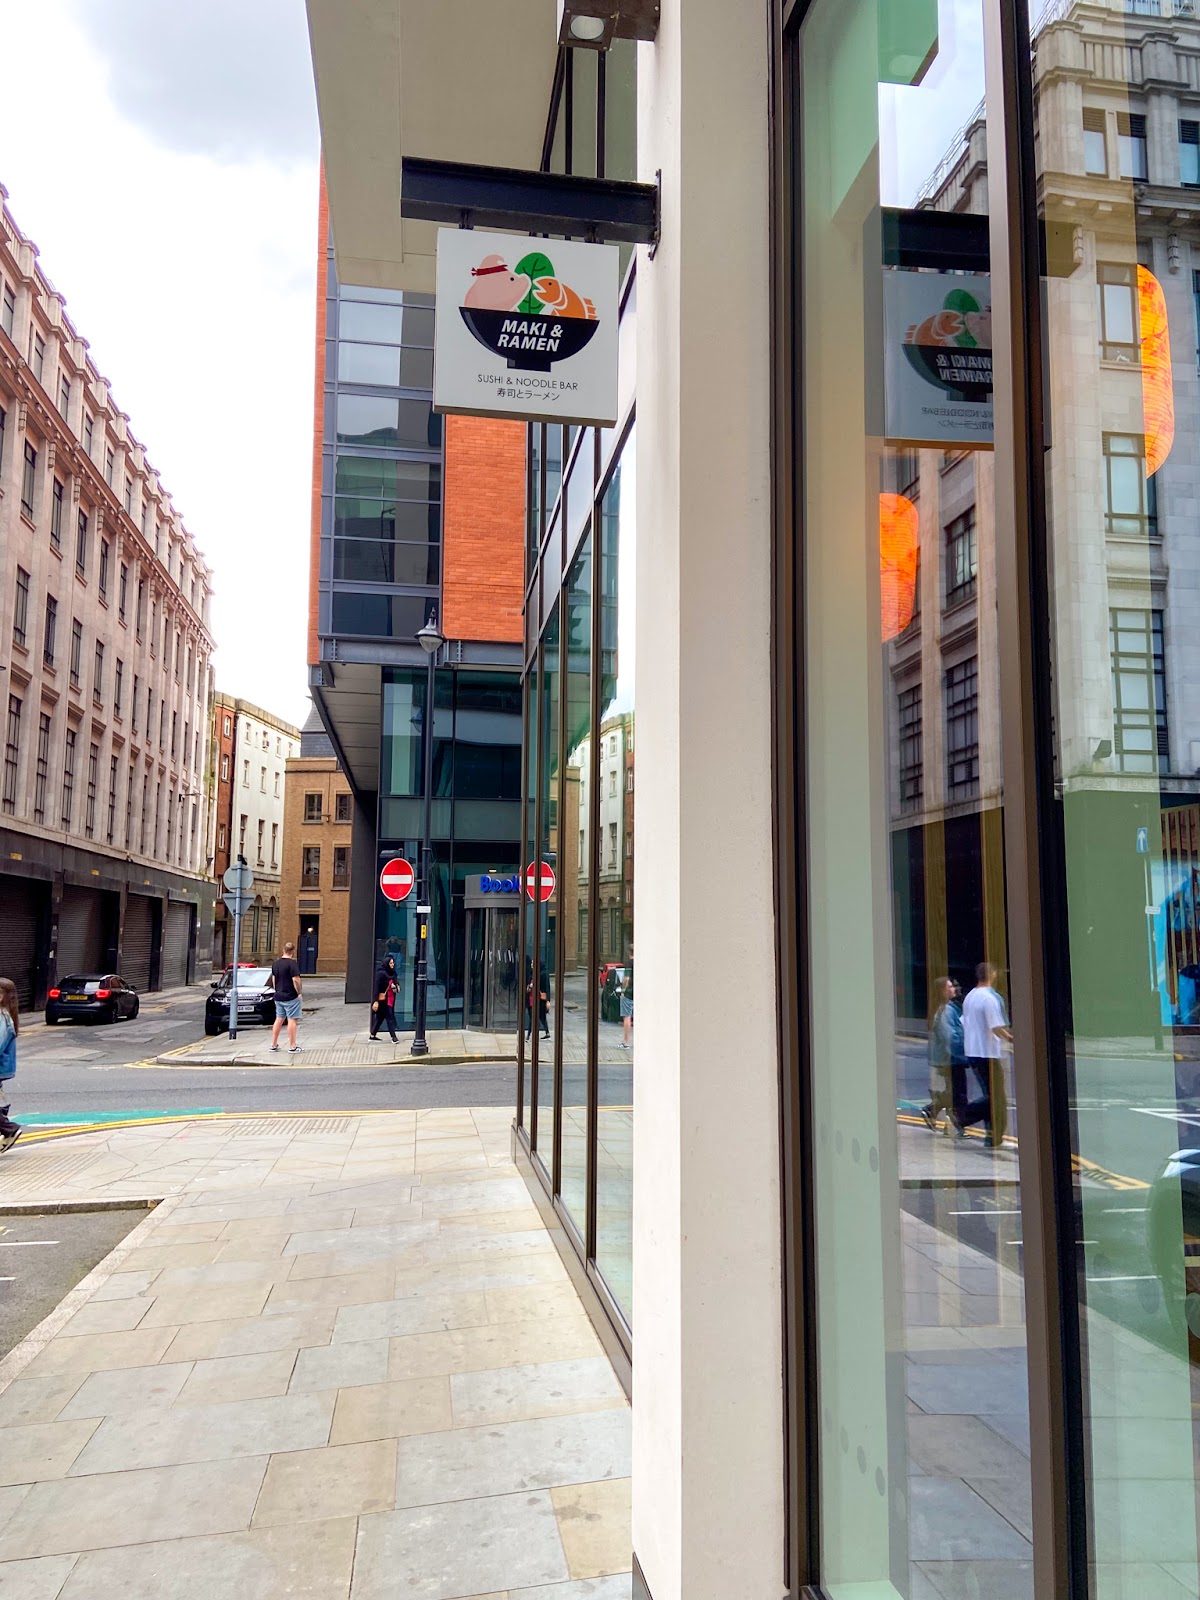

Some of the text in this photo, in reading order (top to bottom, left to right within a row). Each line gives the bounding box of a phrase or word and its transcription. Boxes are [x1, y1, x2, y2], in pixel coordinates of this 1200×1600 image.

[501, 319, 564, 338] MAKI &
[497, 334, 560, 352] RAMEN
[477, 374, 579, 390] SUSHI & NOODLE BAR
[497, 387, 560, 401] 寿司とラーメン
